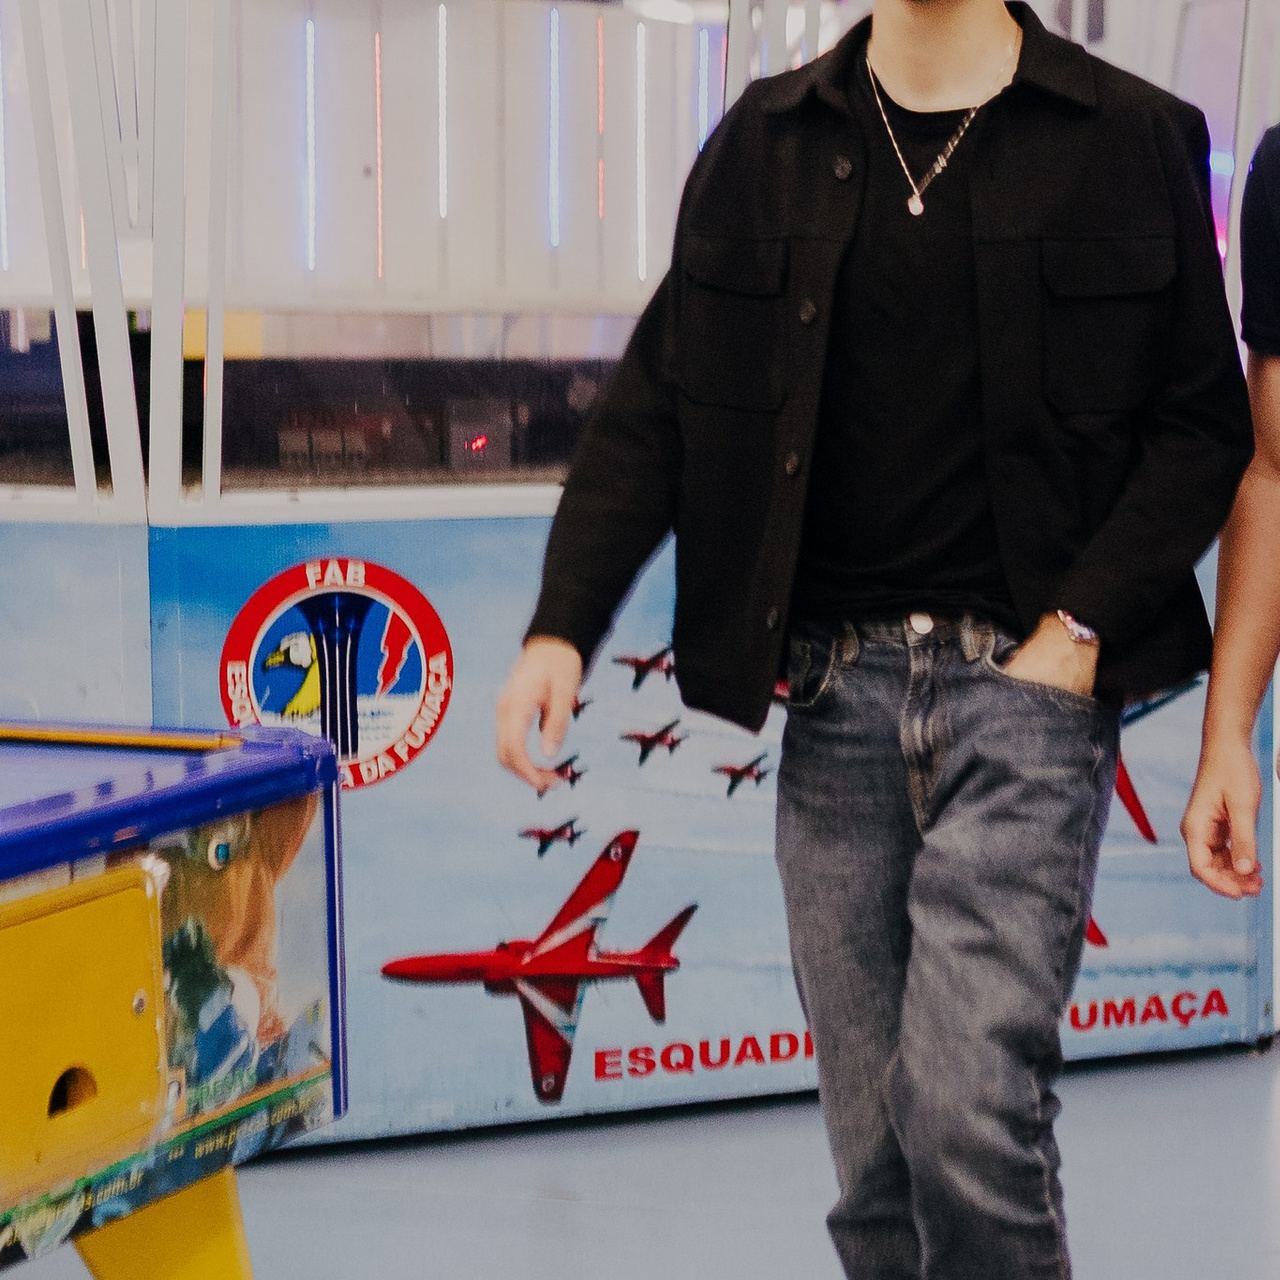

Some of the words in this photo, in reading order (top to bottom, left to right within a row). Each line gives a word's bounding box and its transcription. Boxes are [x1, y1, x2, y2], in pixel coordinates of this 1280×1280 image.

[305, 560, 366, 589] FAB
[360, 753, 396, 785] DA
[394, 651, 452, 762] FUMAÇA
[1066, 987, 1229, 1031] UMAÇA
